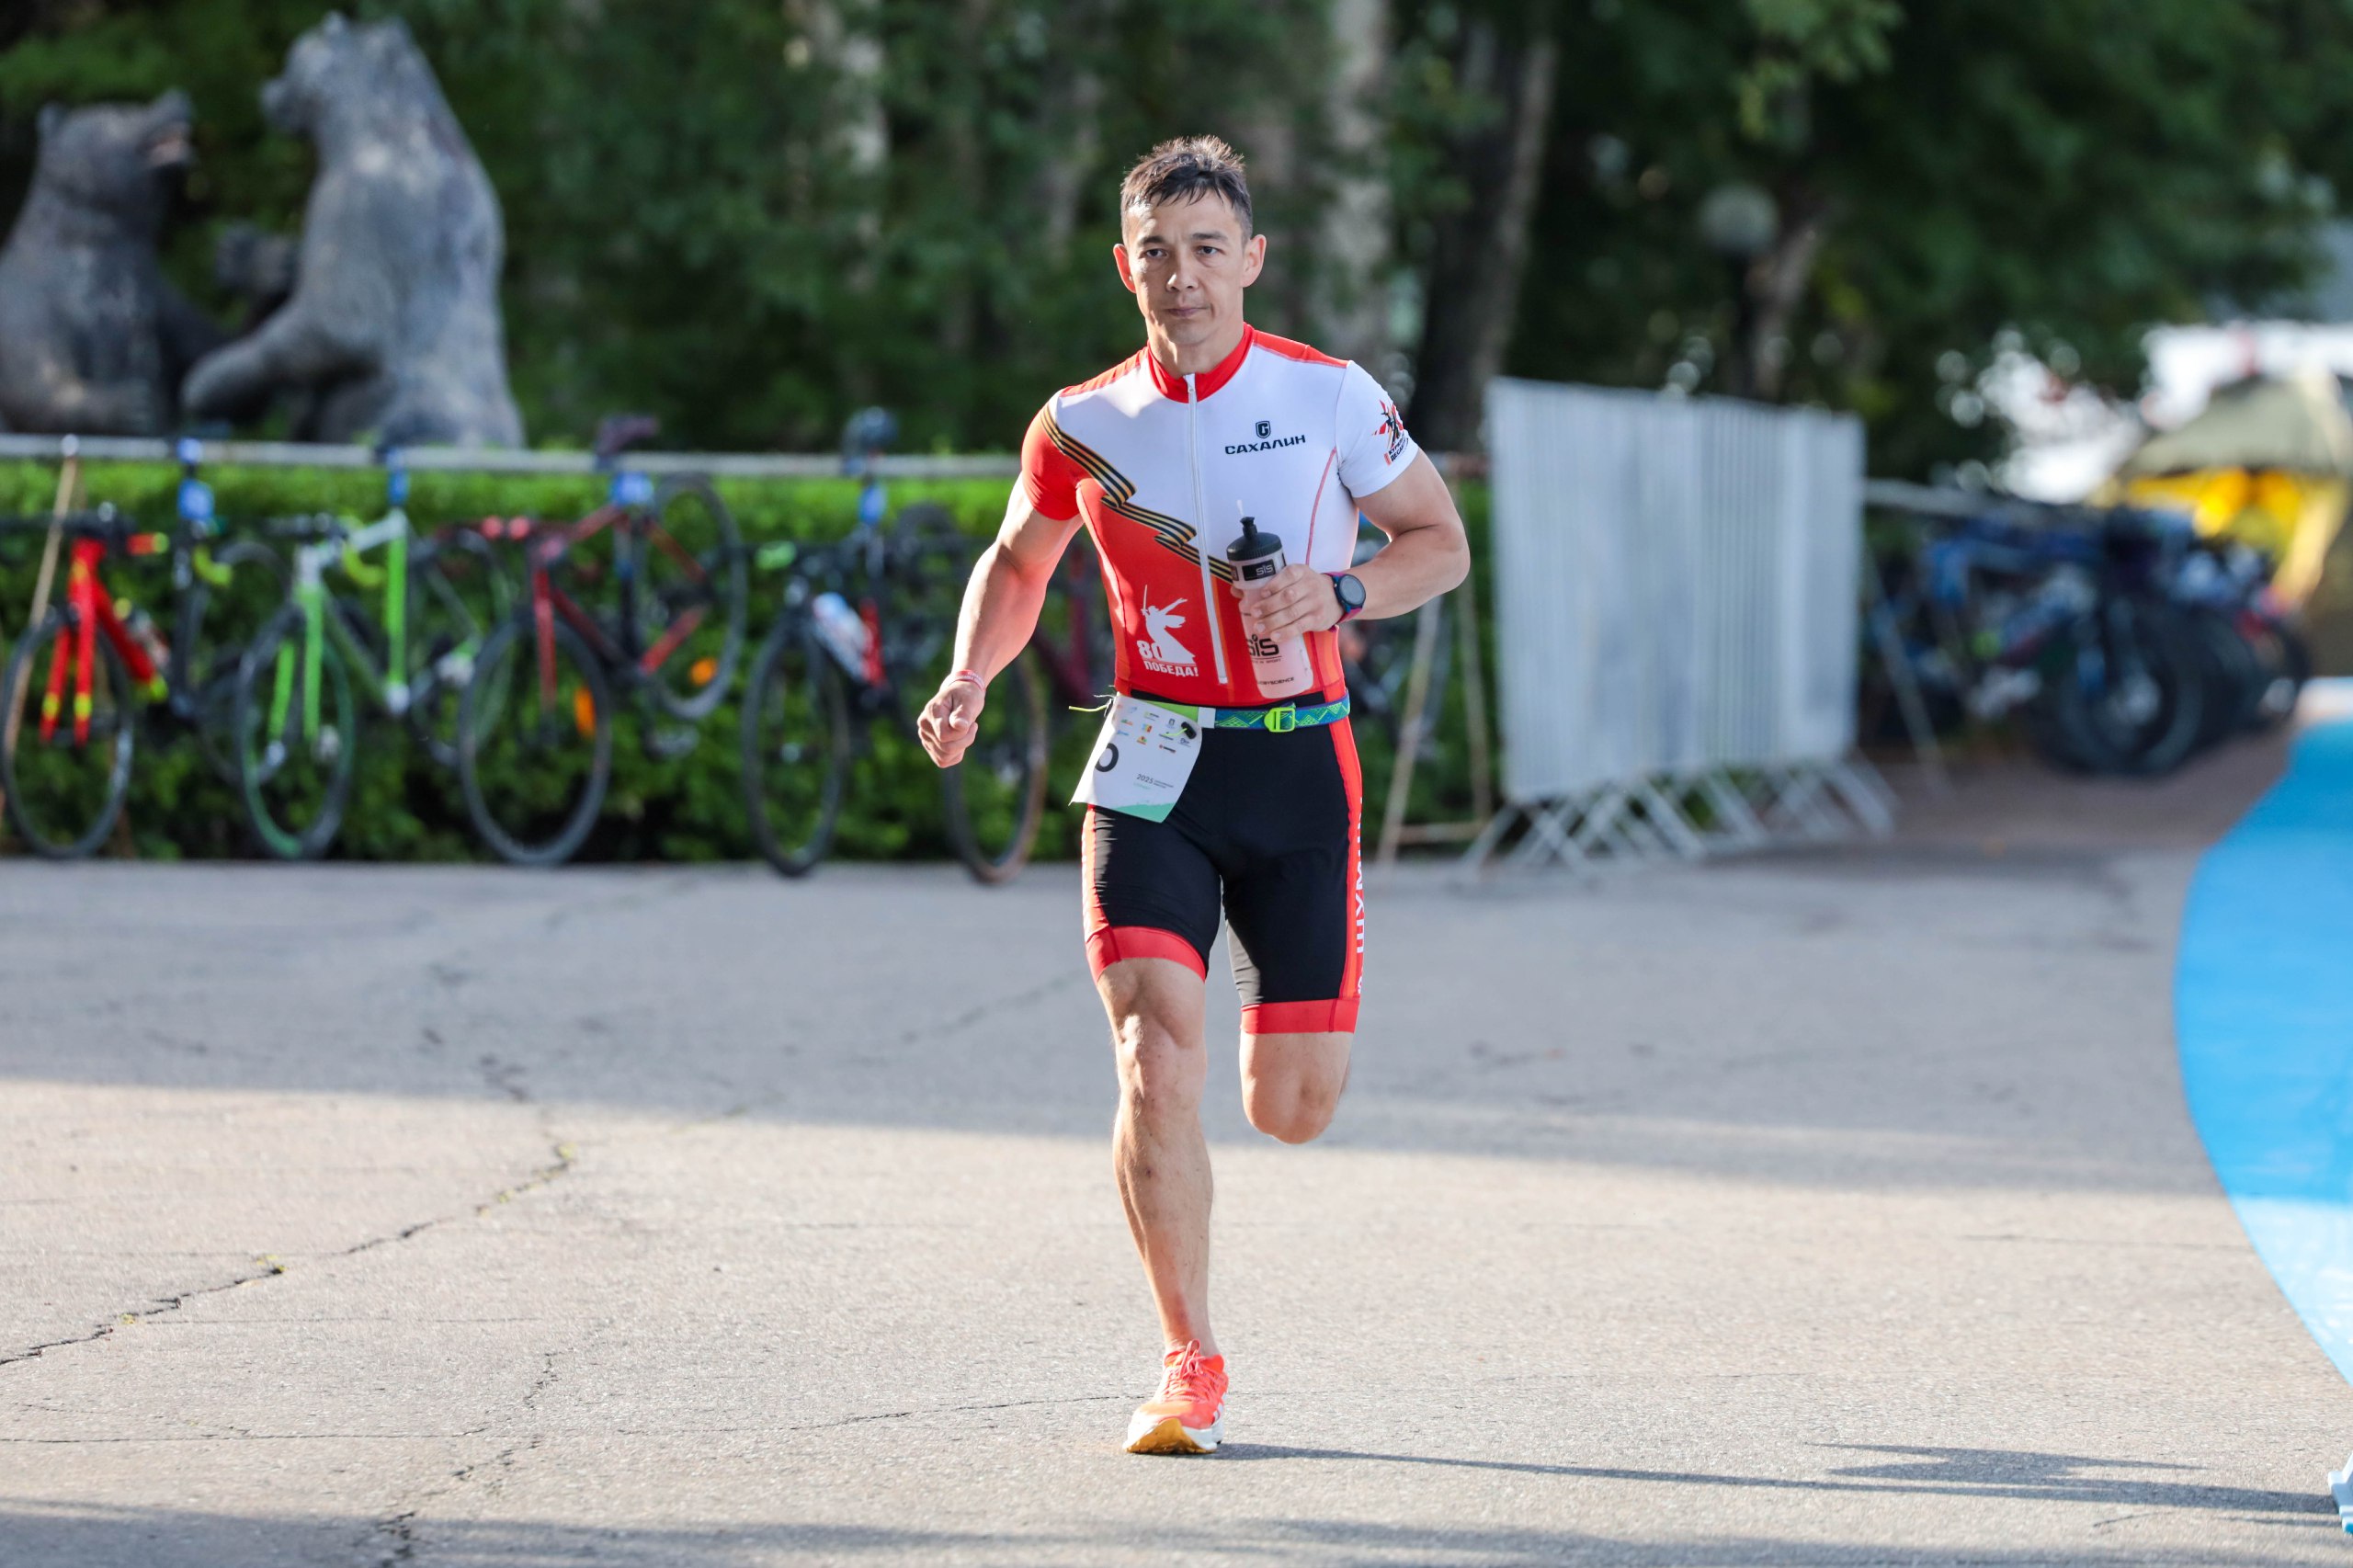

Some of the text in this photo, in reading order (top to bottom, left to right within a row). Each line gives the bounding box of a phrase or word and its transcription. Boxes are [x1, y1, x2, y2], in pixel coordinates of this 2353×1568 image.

[1224, 434, 1306, 455] САХАЛИН
[1136, 640, 1163, 661] 80
[1143, 660, 1199, 677] ПОБЕДА!
[1136, 773, 1154, 784] 2025
